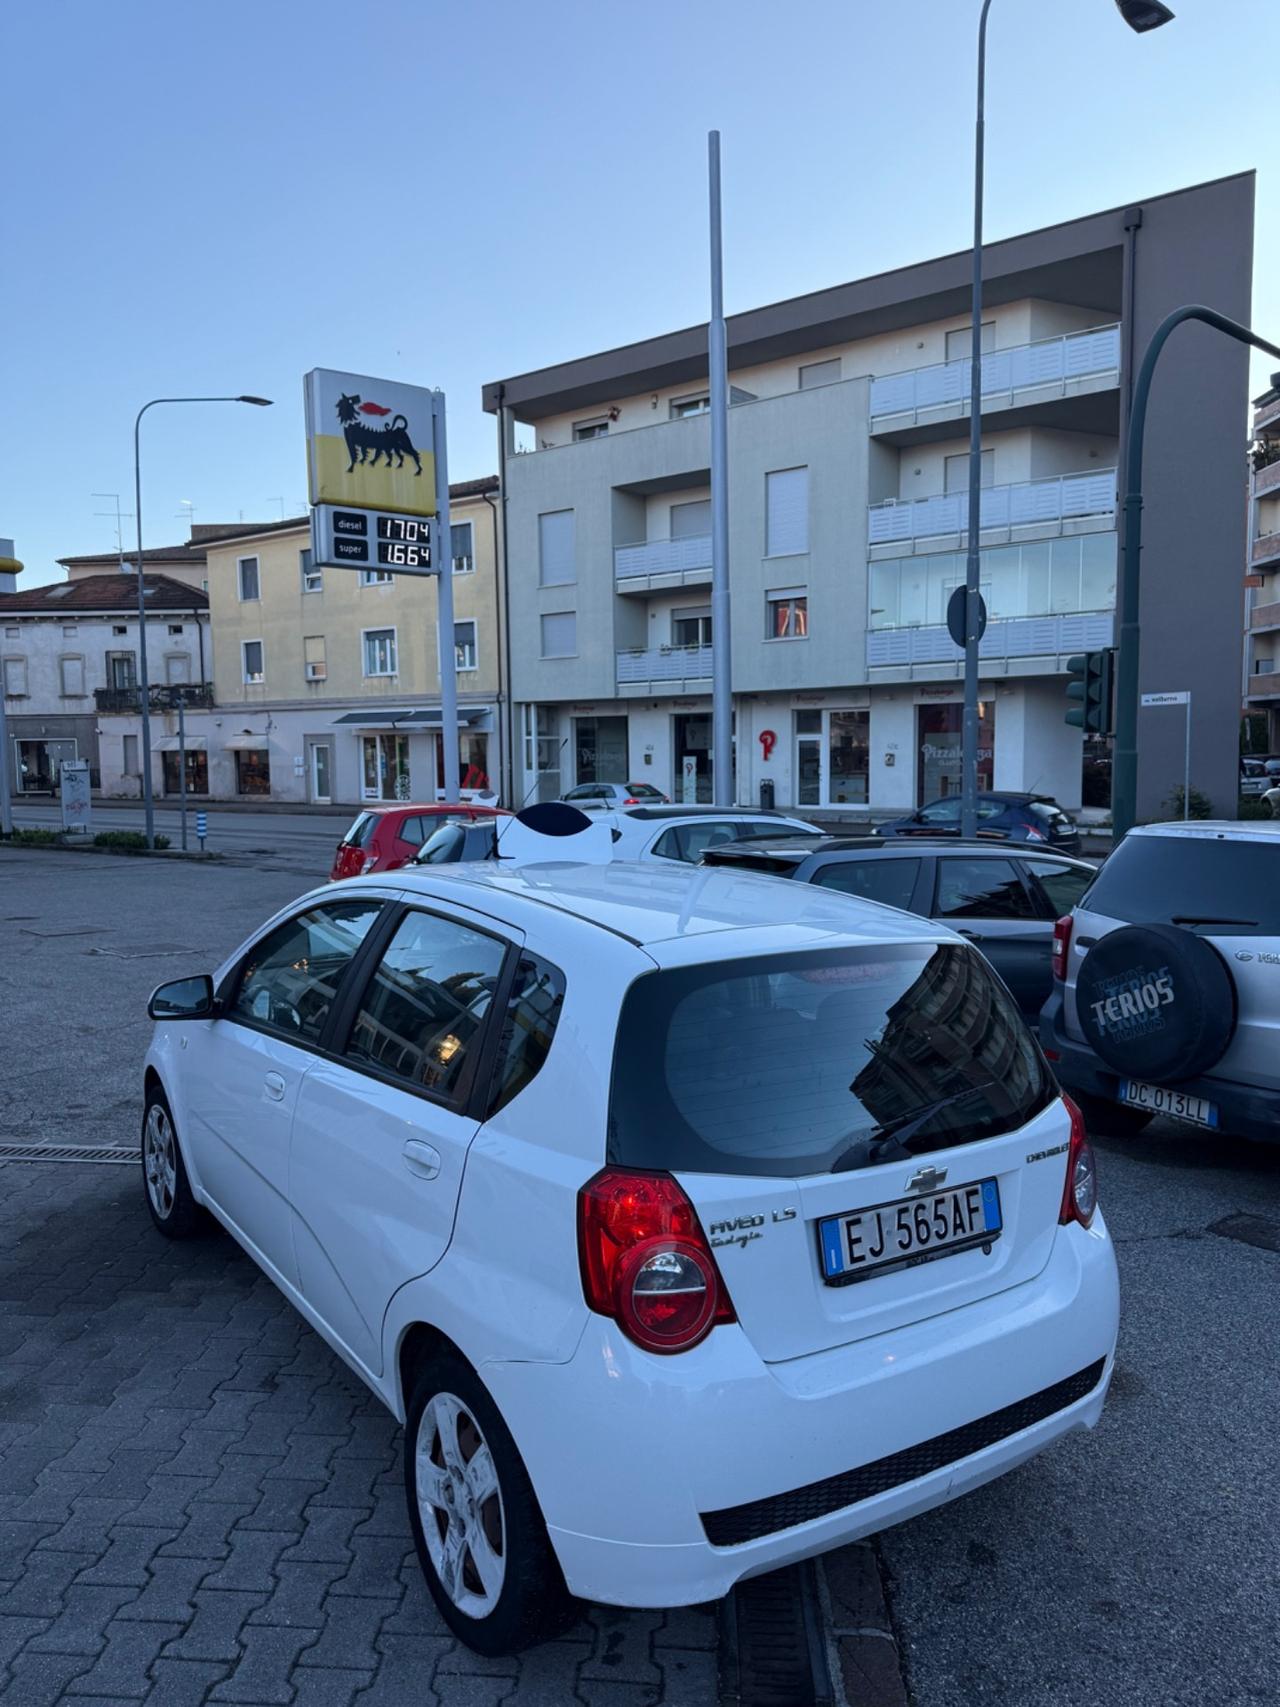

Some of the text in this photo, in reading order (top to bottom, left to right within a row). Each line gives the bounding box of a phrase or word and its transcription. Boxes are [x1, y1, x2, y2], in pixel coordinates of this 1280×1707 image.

[338, 519, 362, 530] diesel
[339, 544, 362, 555] super
[921, 743, 993, 763] Pizzalga
[1090, 977, 1175, 1026] TERIOS
[1129, 1081, 1148, 1103] DC
[1154, 1088, 1207, 1122] 013LL
[709, 1206, 797, 1236] AVEO LS
[845, 1212, 885, 1265] EJ
[896, 1187, 981, 1251] 565AF
